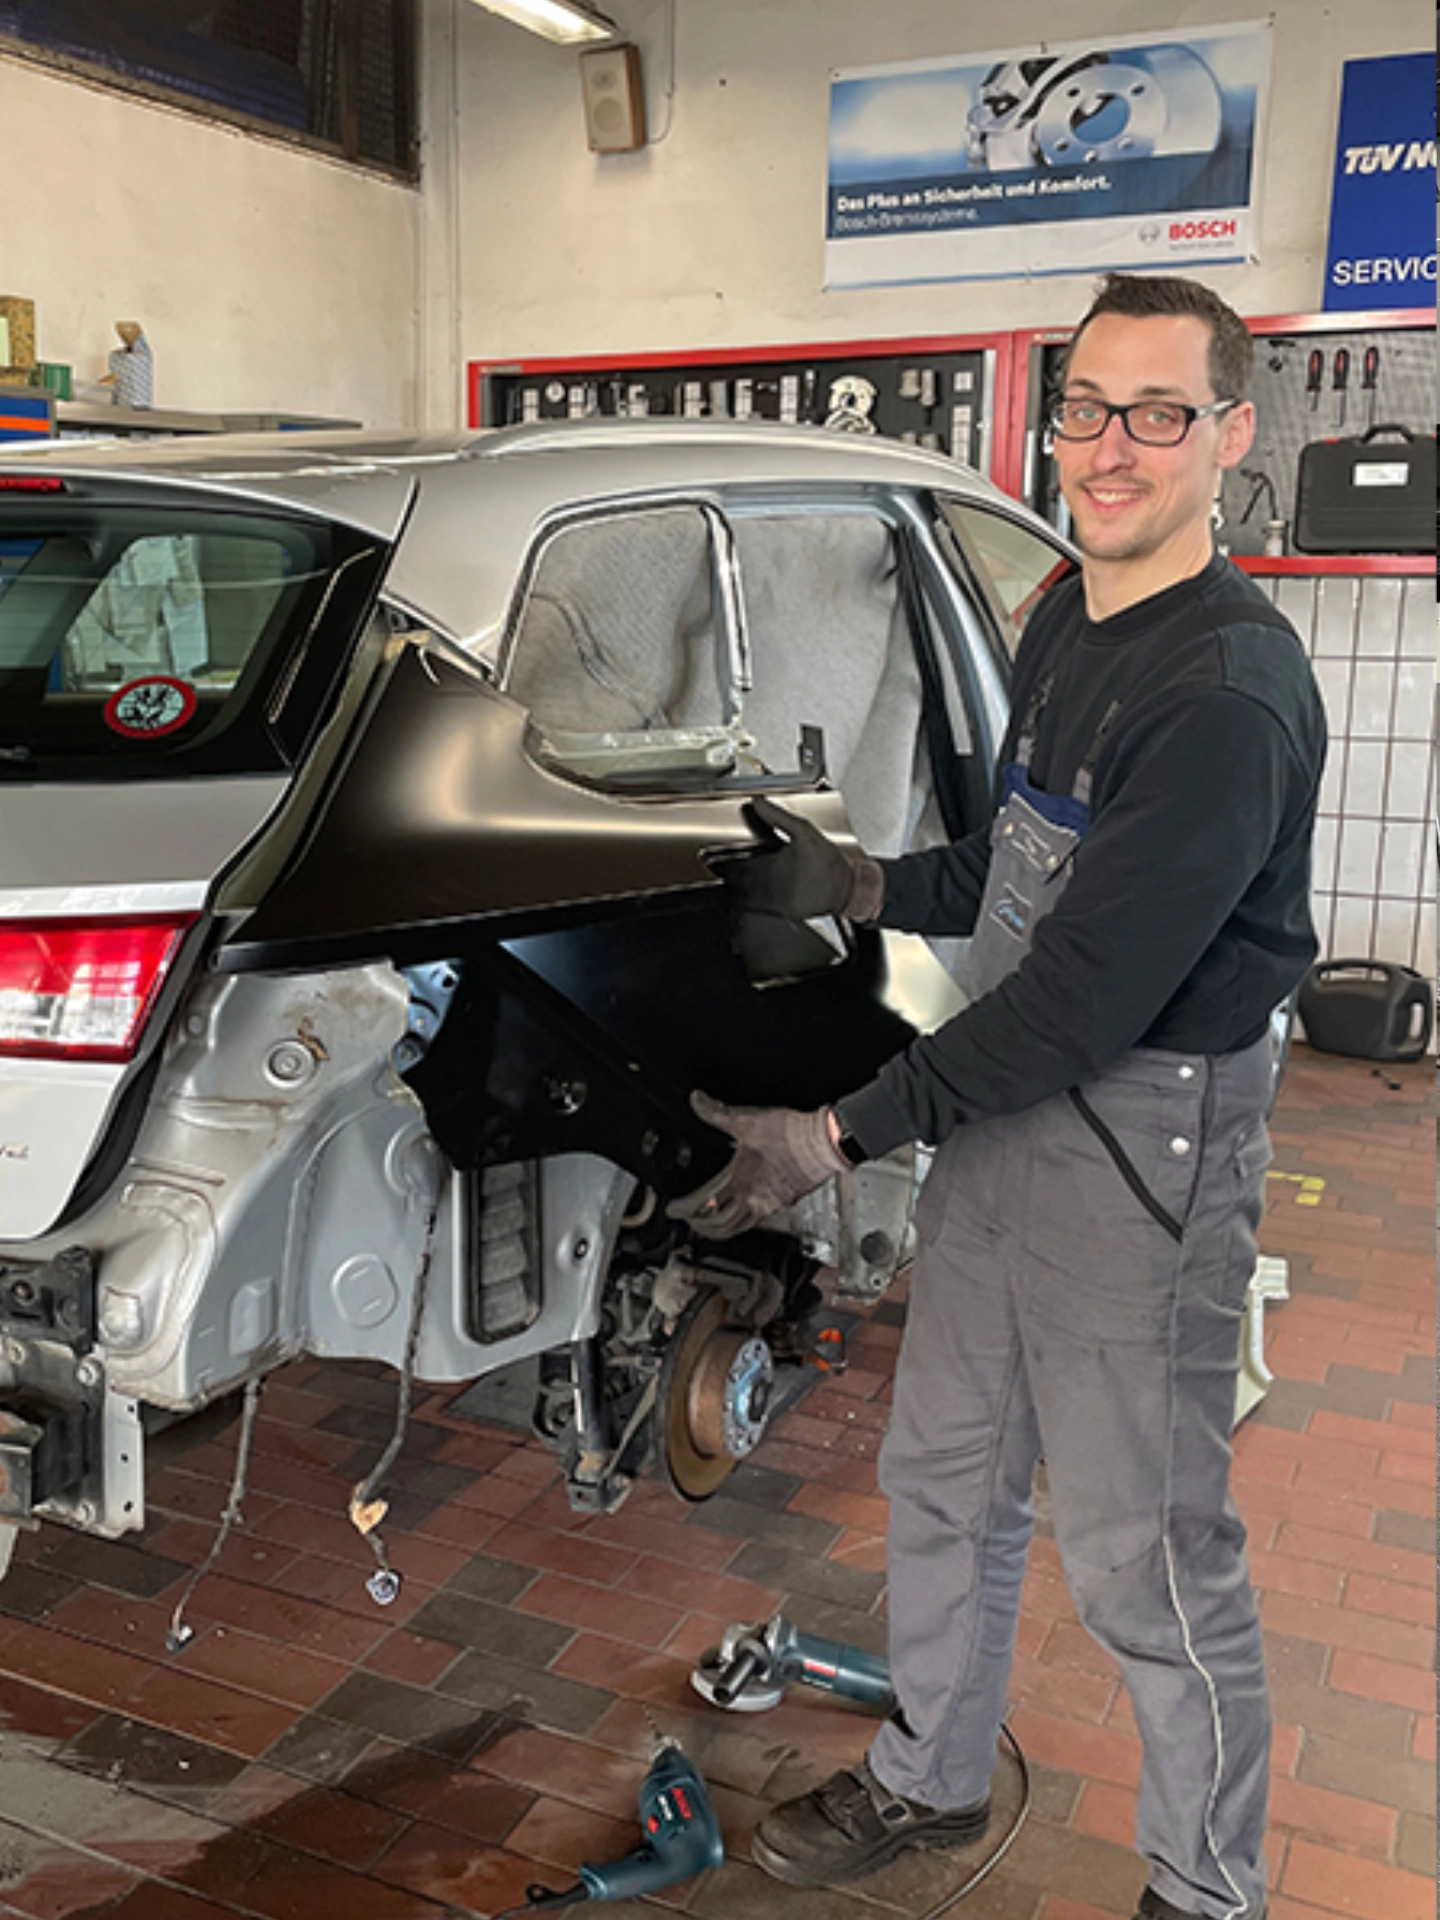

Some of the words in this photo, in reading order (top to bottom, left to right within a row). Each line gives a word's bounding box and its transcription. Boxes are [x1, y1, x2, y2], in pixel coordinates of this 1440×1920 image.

[1344, 144, 1403, 174] TÜV
[1403, 141, 1437, 170] N
[836, 195, 864, 211] Das
[867, 192, 900, 209] Plus
[902, 194, 920, 206] an
[924, 184, 1003, 205] Sicherheit
[1005, 180, 1035, 197] und
[1038, 175, 1112, 194] Komfort.
[1169, 219, 1237, 241] BOSCH
